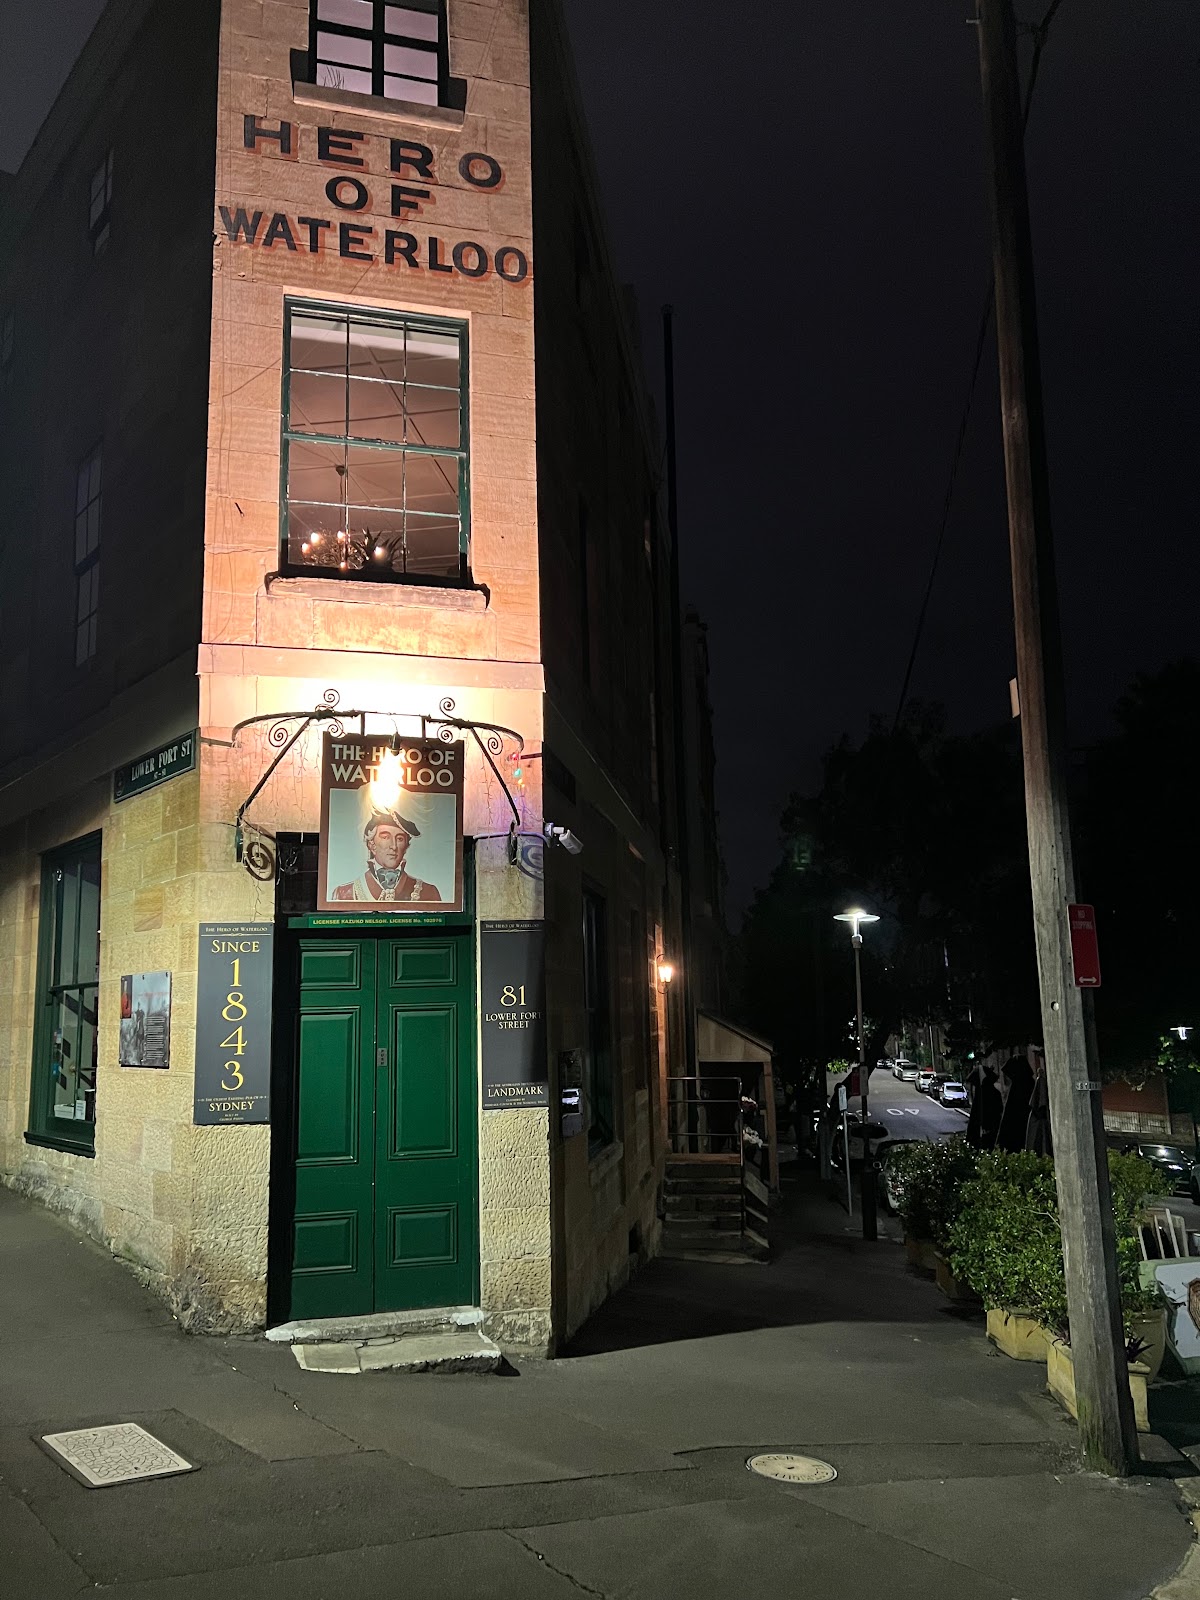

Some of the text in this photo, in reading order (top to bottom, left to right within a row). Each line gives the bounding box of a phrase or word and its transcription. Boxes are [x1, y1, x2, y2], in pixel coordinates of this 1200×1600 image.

[244, 115, 503, 190] HERO
[325, 176, 432, 218] OF
[218, 205, 529, 284] WATERLOO
[131, 758, 155, 781] LOWER
[158, 746, 178, 768] FORT
[181, 739, 191, 757] ST
[331, 744, 455, 765] THE HRO OF
[331, 763, 454, 786] WATRLOO
[211, 939, 260, 953] SINCE
[500, 985, 527, 1007] 81
[485, 1012, 541, 1021] LOWER FORT
[498, 1020, 529, 1029] STREET
[488, 1086, 543, 1098] LANDMARK
[208, 1101, 254, 1112] SYDNEY
